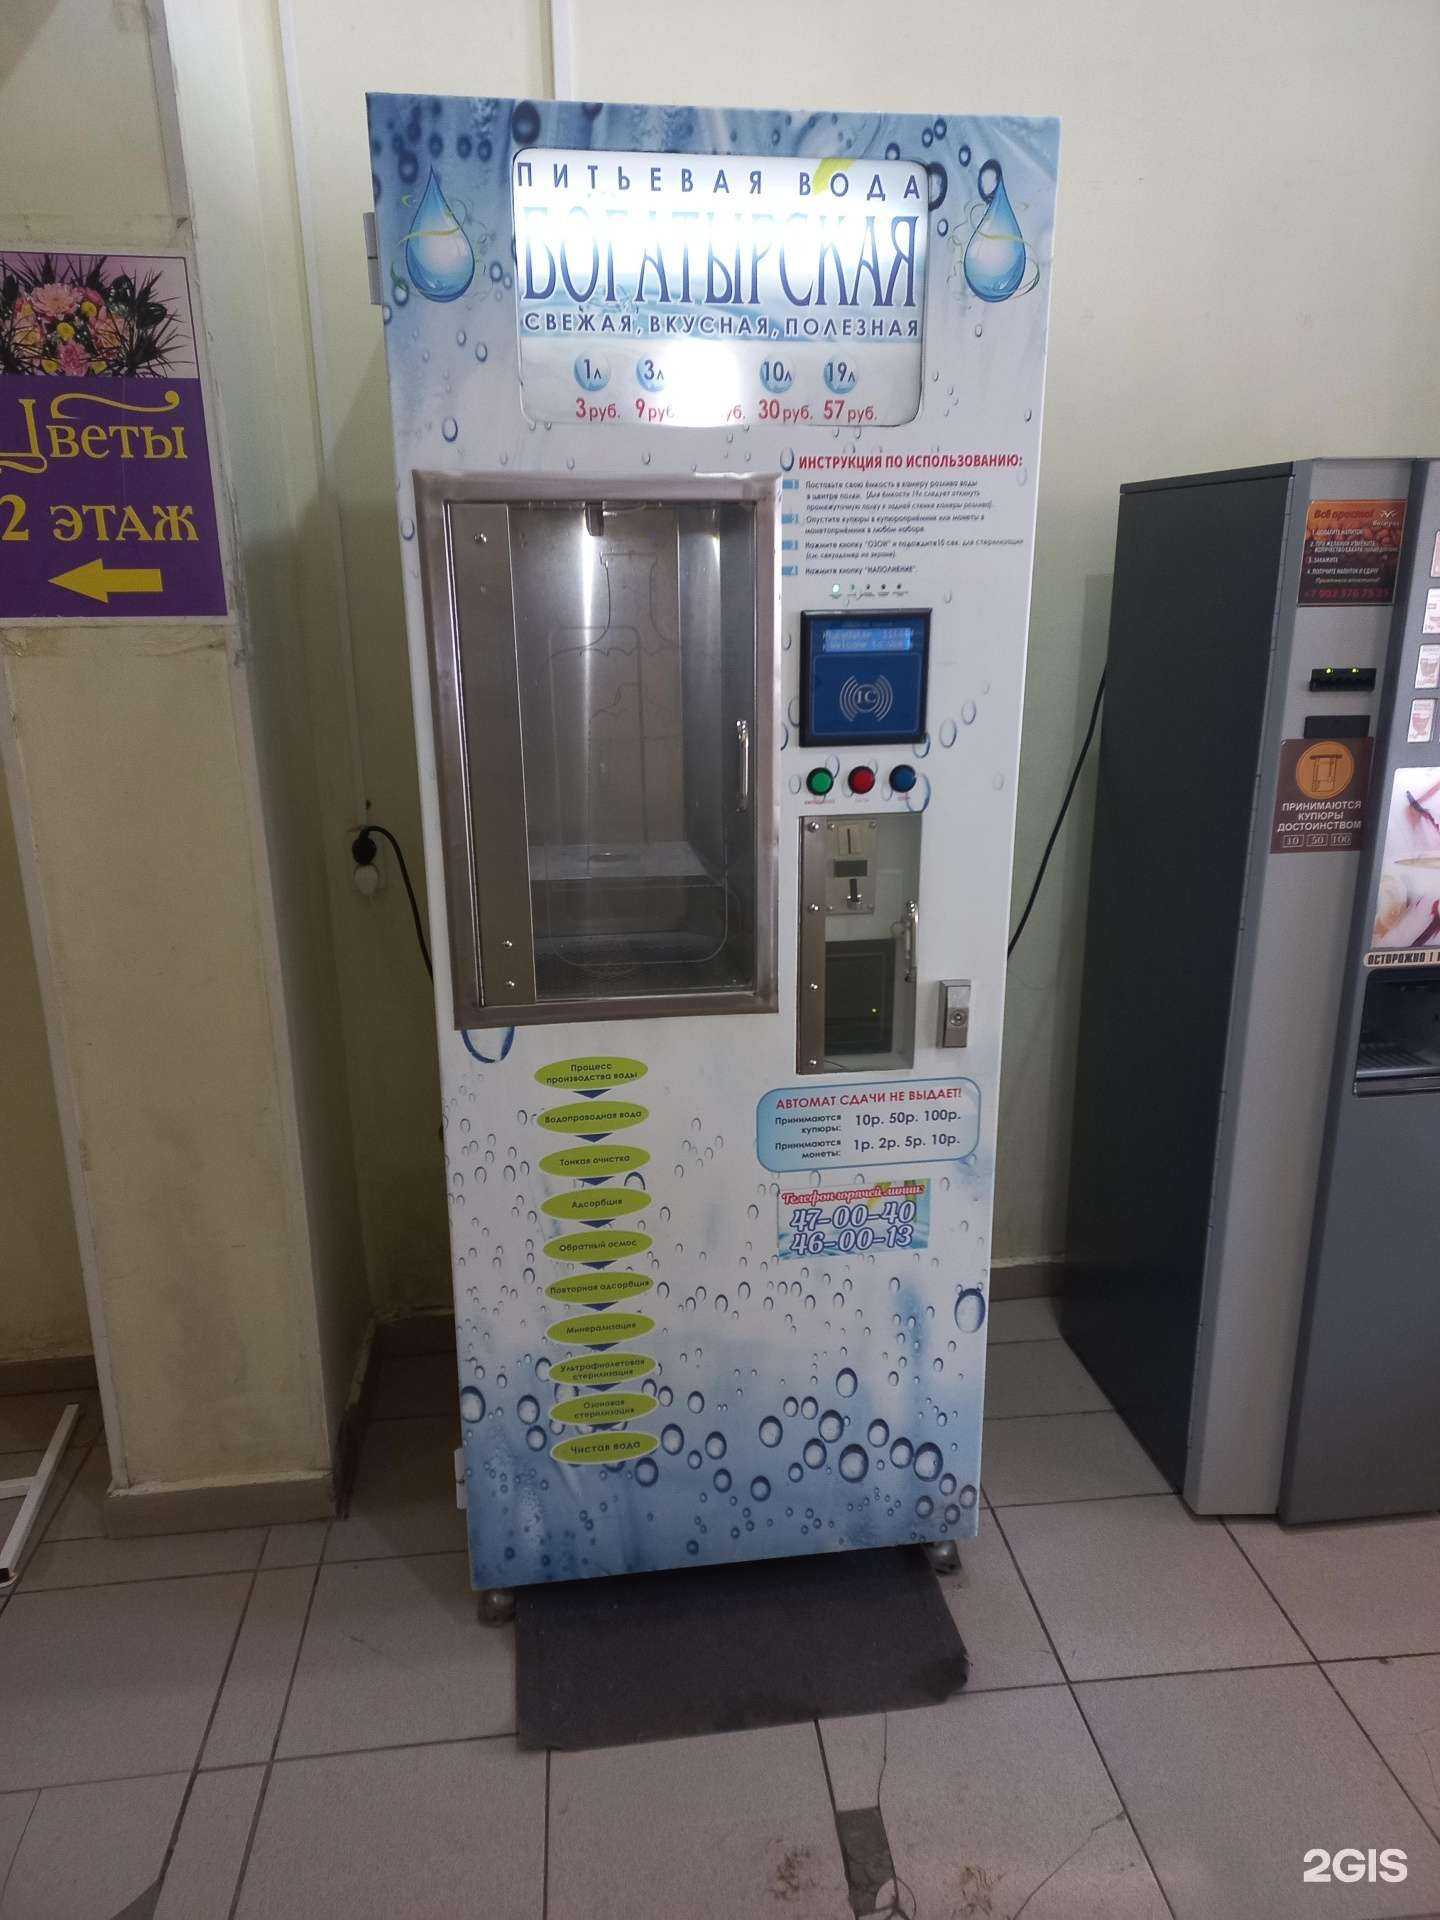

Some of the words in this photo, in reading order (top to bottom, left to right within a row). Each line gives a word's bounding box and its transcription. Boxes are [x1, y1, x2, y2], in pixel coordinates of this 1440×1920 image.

[517, 163, 763, 194] ПИТЬЕВАЯ
[799, 171, 920, 202] ВОДА
[522, 206, 919, 307] БОГАТЫРСКАЯ
[524, 312, 641, 335] СВЕЖАЯ,
[650, 315, 778, 339] ВКУСНАЯ,
[785, 318, 919, 337] ПОЛЕЗНАЯ
[763, 361, 793, 382] 10л
[828, 361, 856, 383] 19л
[799, 455, 882, 471] ИНСТРУКЦИЯ
[886, 456, 902, 468] ПО
[906, 454, 1023, 468] ИСПОЛЬЗОВАНИЮ:
[0, 494, 29, 541] 2
[50, 504, 200, 542] ЭТАЖ
[1282, 801, 1361, 811] ПРИНИМАЮТСЯ
[1298, 811, 1344, 820] КУПЮРЫ
[1278, 821, 1361, 832] ДОСТОИНСТВОМ
[1368, 953, 1425, 964] ОСТОРОЖНО
[571, 1063, 613, 1072] Процесс
[547, 1074, 611, 1084] производства
[613, 1072, 637, 1080] воды
[776, 1096, 836, 1110] АВТОМАТ
[840, 1094, 885, 1106] СДАЧИ
[890, 1092, 905, 1102] НЕ
[909, 1088, 962, 1101] ВЫДАЕТ!
[545, 1113, 617, 1123] Водопроводная
[775, 1113, 842, 1126] Принимаются
[856, 1115, 884, 1127] 10р.
[889, 1112, 918, 1124] 50р.
[924, 1109, 961, 1123] 100р.
[801, 1125, 842, 1135] купюры:
[775, 1139, 842, 1151] Принимаются
[854, 1139, 874, 1152] 1р.
[879, 1138, 900, 1150] 2р.
[905, 1136, 926, 1148] 5р.
[931, 1134, 960, 1146] 10р.
[593, 1155, 630, 1163] очистка
[802, 1150, 841, 1159] монеты:
[572, 1198, 622, 1209] Адсорбция
[781, 1190, 835, 1207] Телефон
[790, 1200, 916, 1232] 47-00-40
[559, 1241, 606, 1252] Обратный
[608, 1240, 637, 1248] осмос
[790, 1225, 913, 1255] 46-00-13
[550, 1283, 598, 1295] Повторная
[600, 1280, 650, 1290] адсорбция
[566, 1322, 636, 1334] Минерализация
[570, 1444, 610, 1455] Чистая
[613, 1441, 640, 1450] вода
